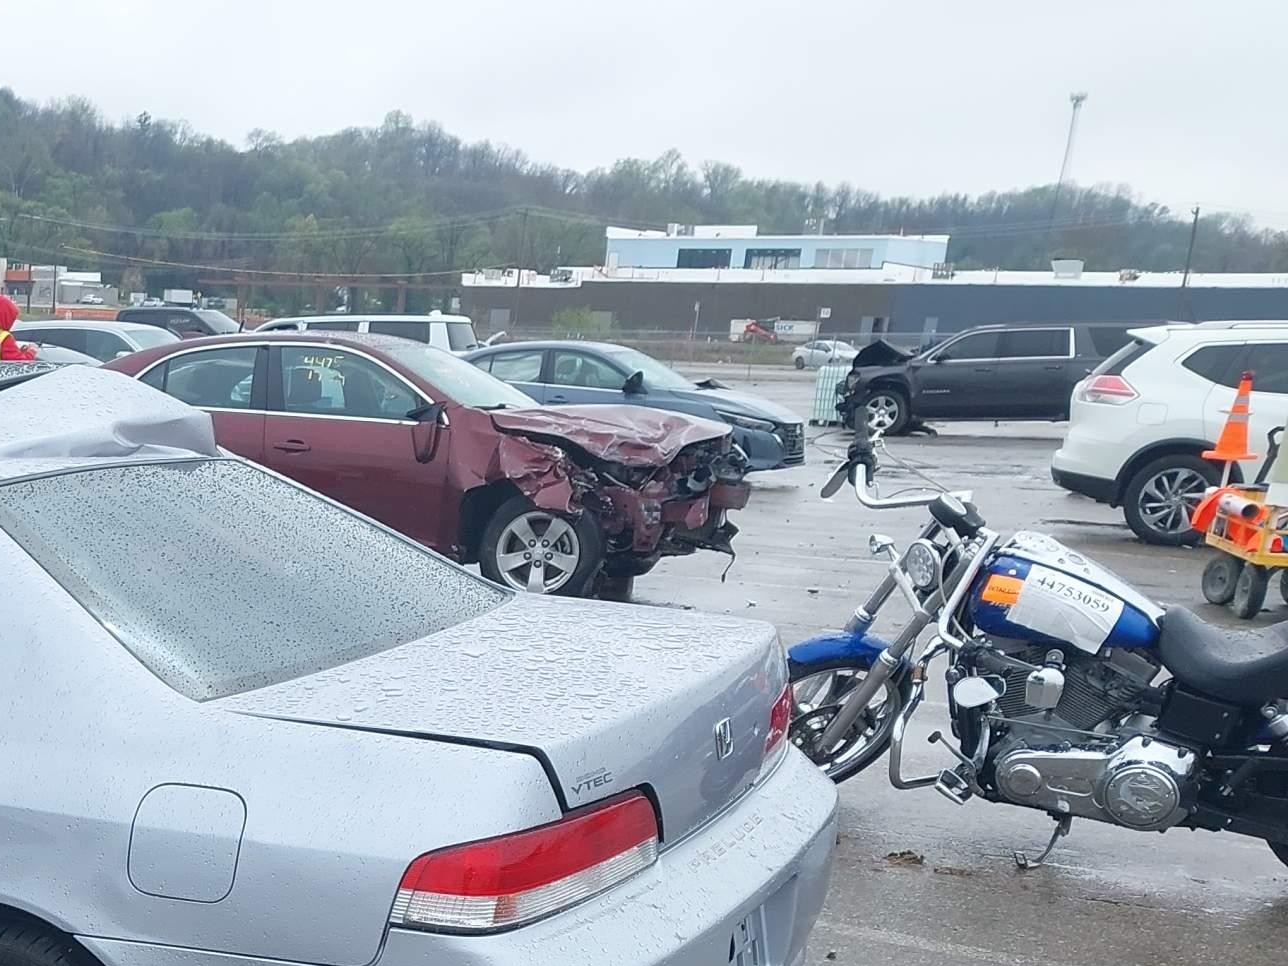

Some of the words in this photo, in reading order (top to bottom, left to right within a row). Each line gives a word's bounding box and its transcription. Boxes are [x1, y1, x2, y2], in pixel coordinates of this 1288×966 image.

[1037, 577, 1111, 613] 44753059
[571, 771, 614, 795] VTEC
[687, 811, 763, 874] PRELUDE
